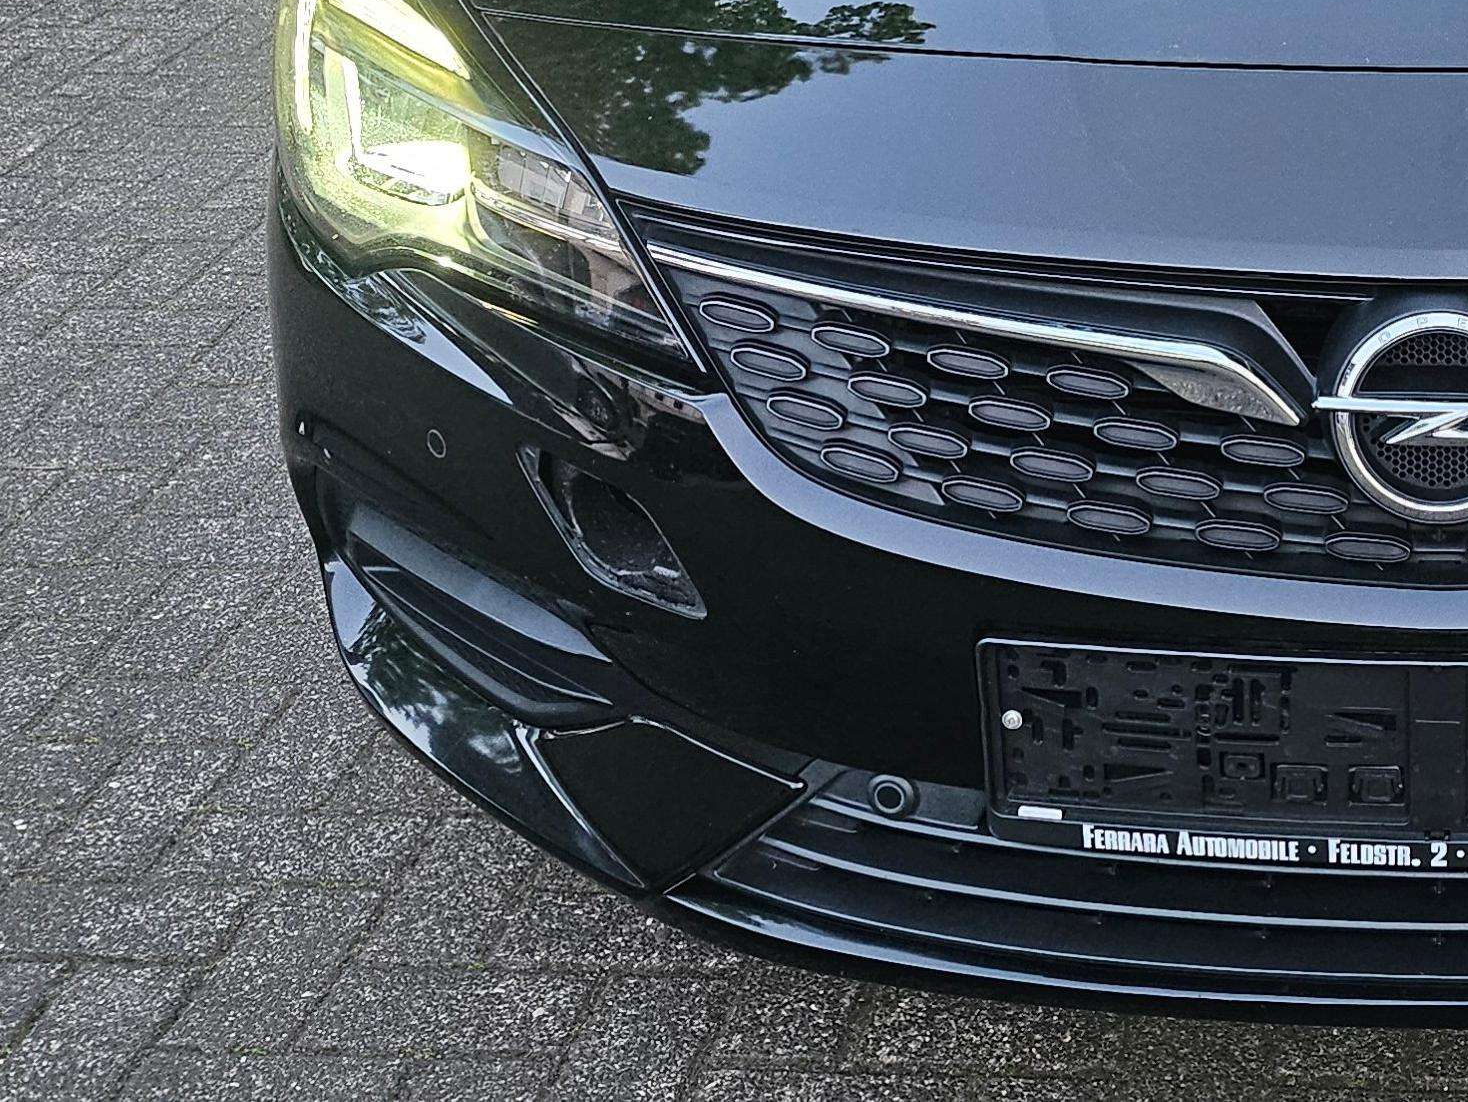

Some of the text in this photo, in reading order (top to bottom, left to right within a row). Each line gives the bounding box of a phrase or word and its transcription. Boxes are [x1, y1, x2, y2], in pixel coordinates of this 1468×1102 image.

[1082, 823, 1170, 854] FERRARA
[1176, 830, 1300, 862] AUTOMOBILE
[1328, 838, 1421, 867] FELDSTR.
[1430, 841, 1448, 867] 2
